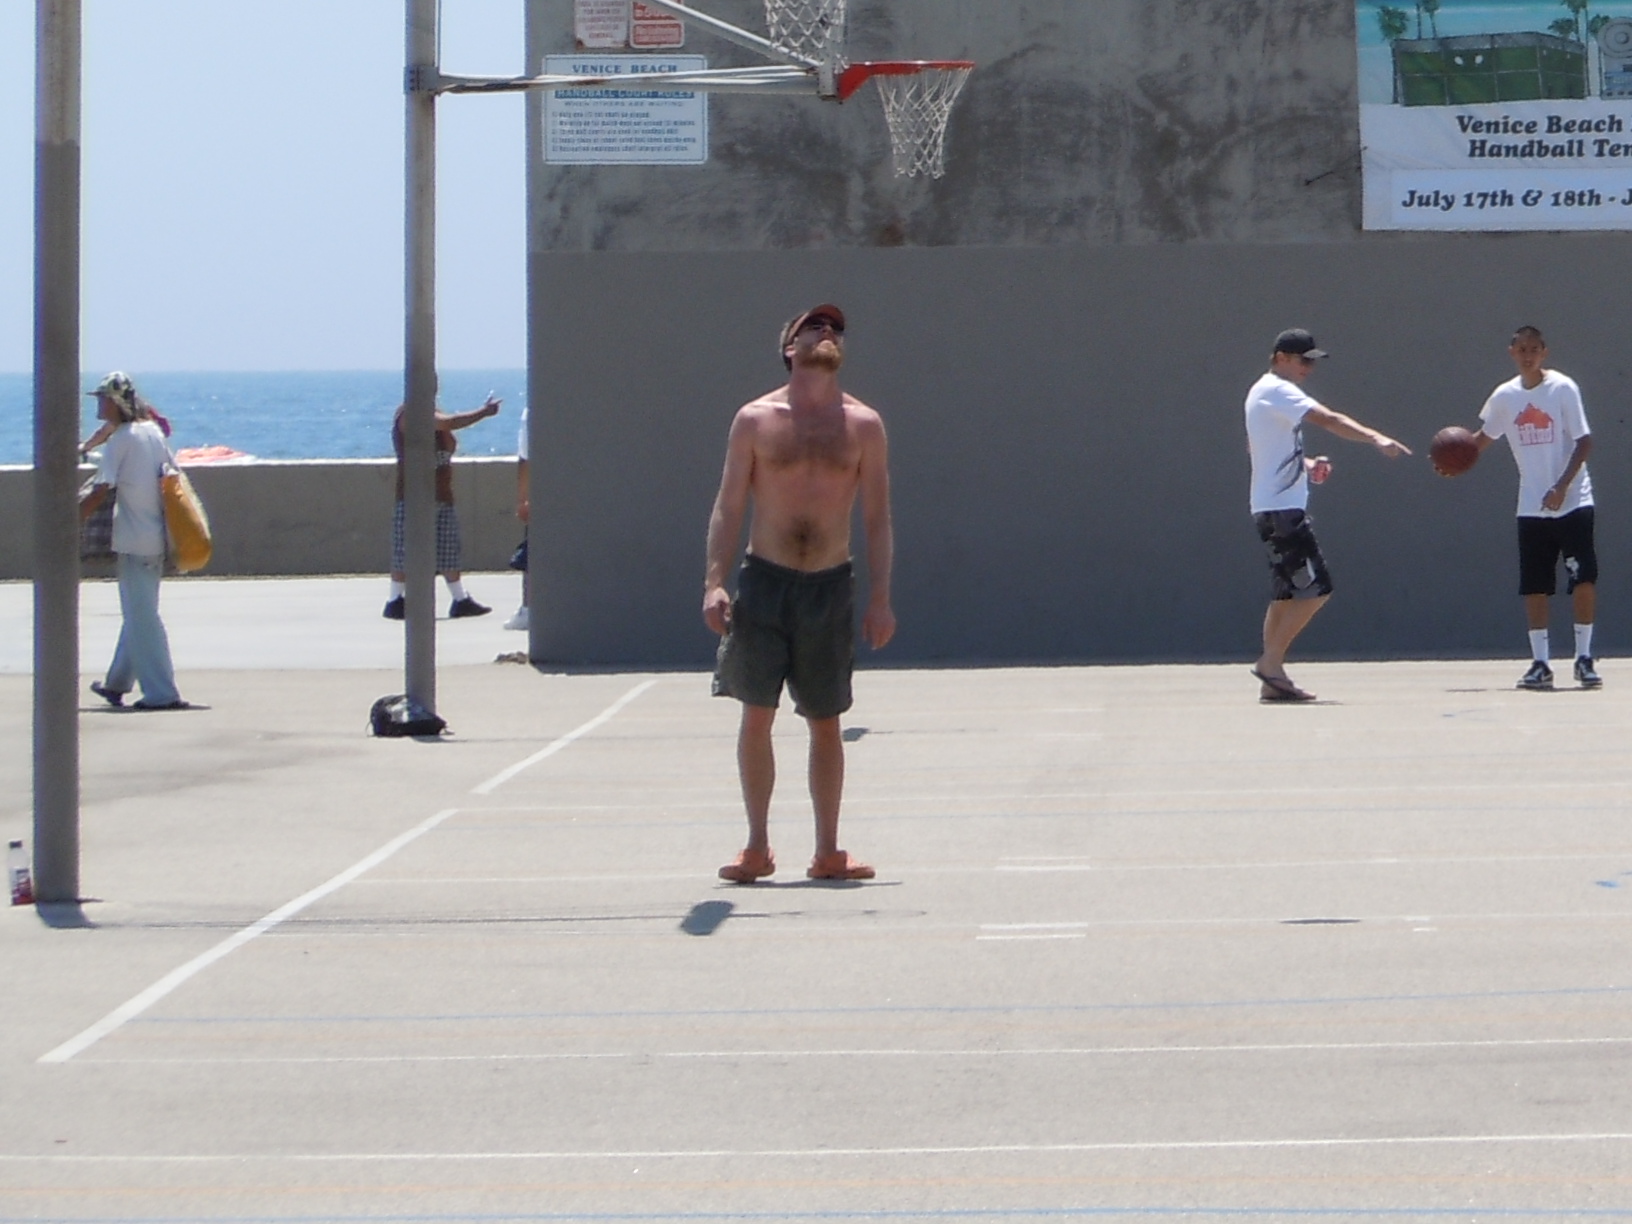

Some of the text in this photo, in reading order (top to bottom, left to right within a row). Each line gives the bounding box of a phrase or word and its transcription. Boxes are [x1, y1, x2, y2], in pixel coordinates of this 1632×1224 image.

[572, 65, 678, 74] VENICE BEACH
[1456, 115, 1538, 134] Venice
[1547, 113, 1622, 133] Beach
[1468, 138, 1585, 158] Handball
[1401, 189, 1455, 211] July
[1462, 188, 1516, 209] 17th
[1521, 188, 1543, 208] &
[1549, 187, 1602, 208] 18th
